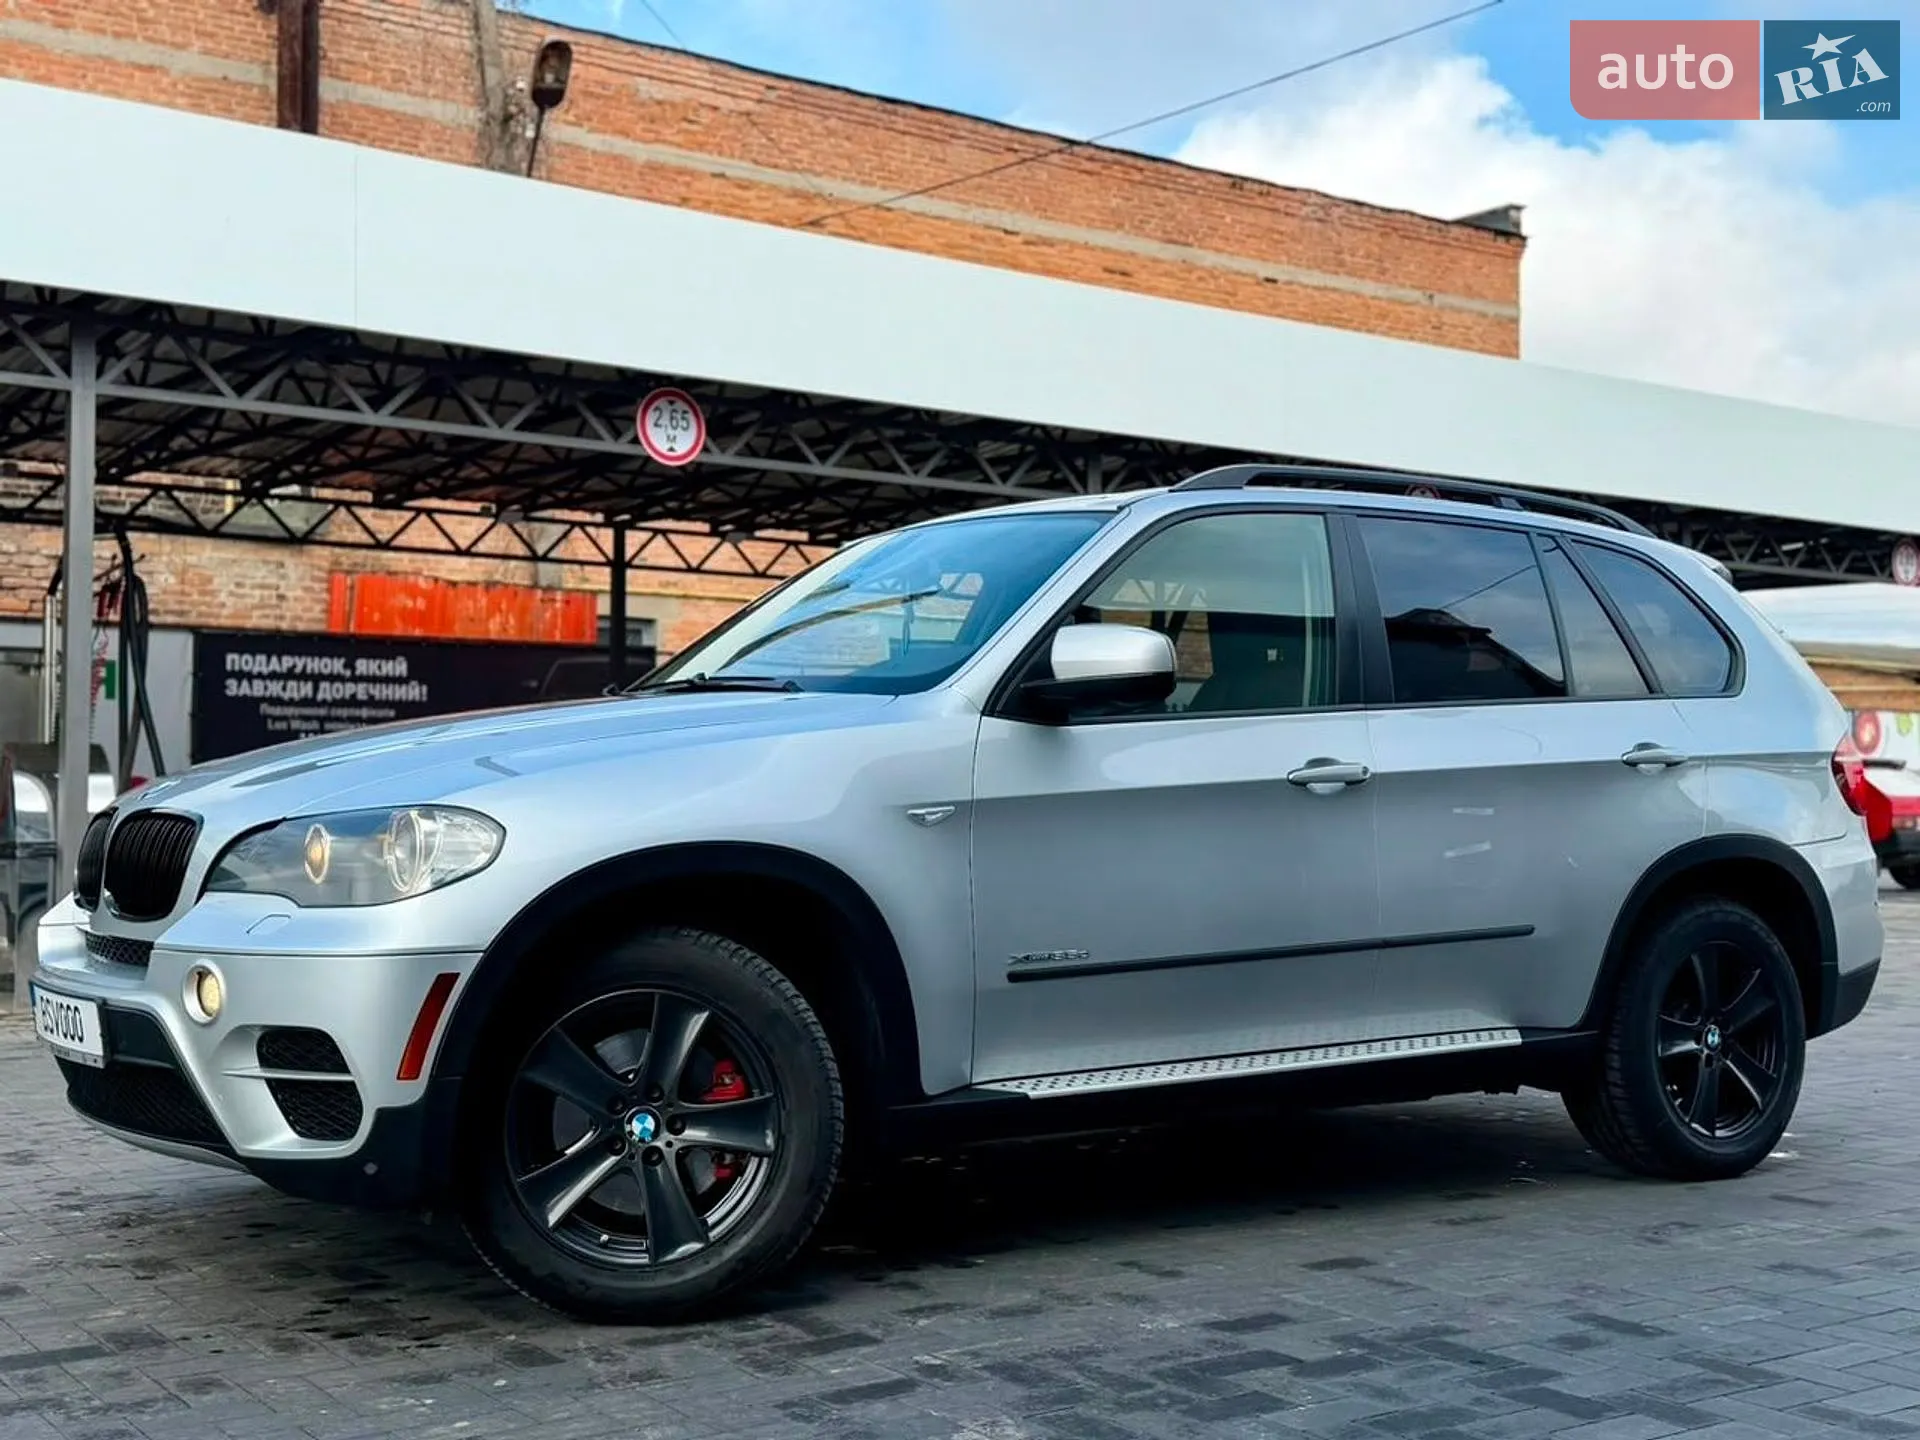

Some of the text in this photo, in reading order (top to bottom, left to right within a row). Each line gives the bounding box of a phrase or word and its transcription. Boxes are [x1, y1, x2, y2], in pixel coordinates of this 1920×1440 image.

[225, 653, 408, 677] ПОДАРУНОК, ЯКИЙ
[225, 678, 428, 702] ЗАВЖДИ ДОРЕЧНИЙ!
